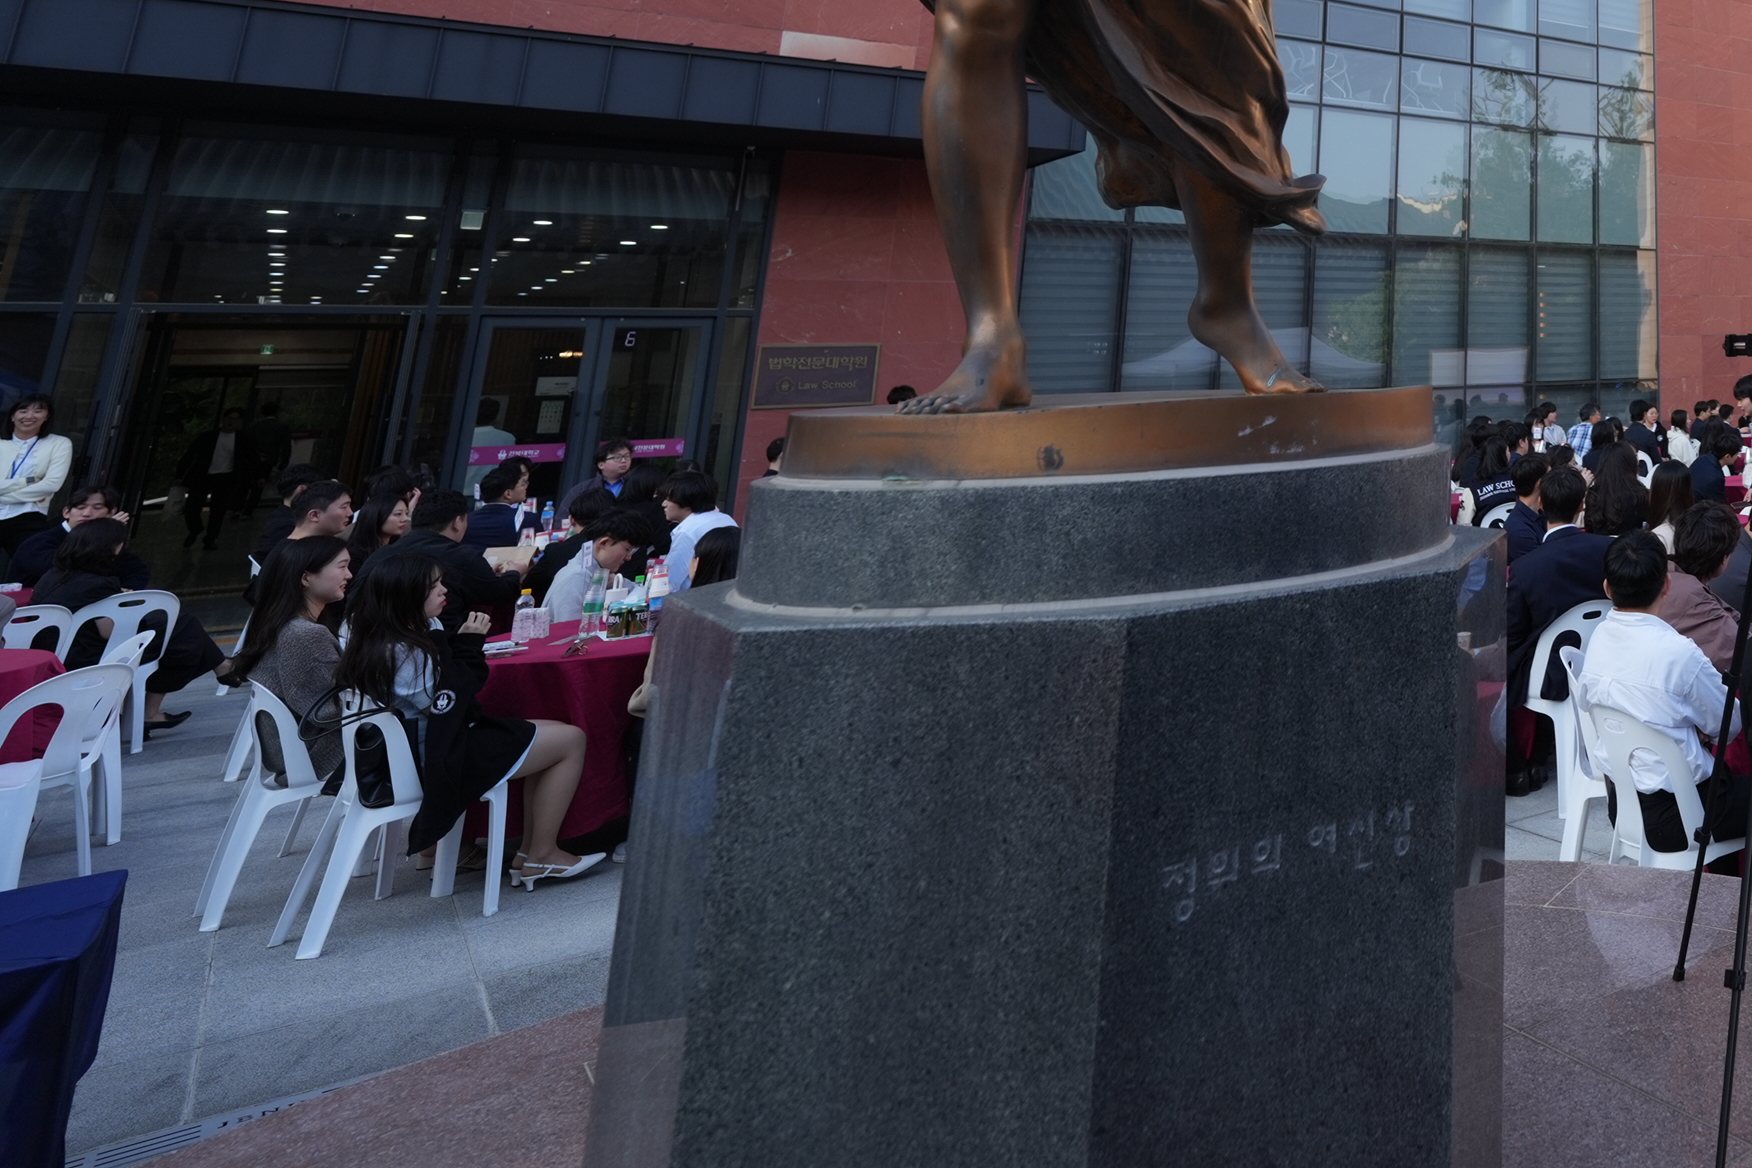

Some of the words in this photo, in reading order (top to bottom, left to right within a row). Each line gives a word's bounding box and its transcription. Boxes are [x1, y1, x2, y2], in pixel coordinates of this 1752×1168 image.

[625, 332, 636, 346] 6
[768, 356, 868, 370] 법학전문대학원
[798, 382, 819, 390] Law
[821, 380, 857, 389] School
[1477, 483, 1494, 496] LAW
[1161, 832, 1282, 922] 정의의
[1307, 801, 1415, 871] 여신상
